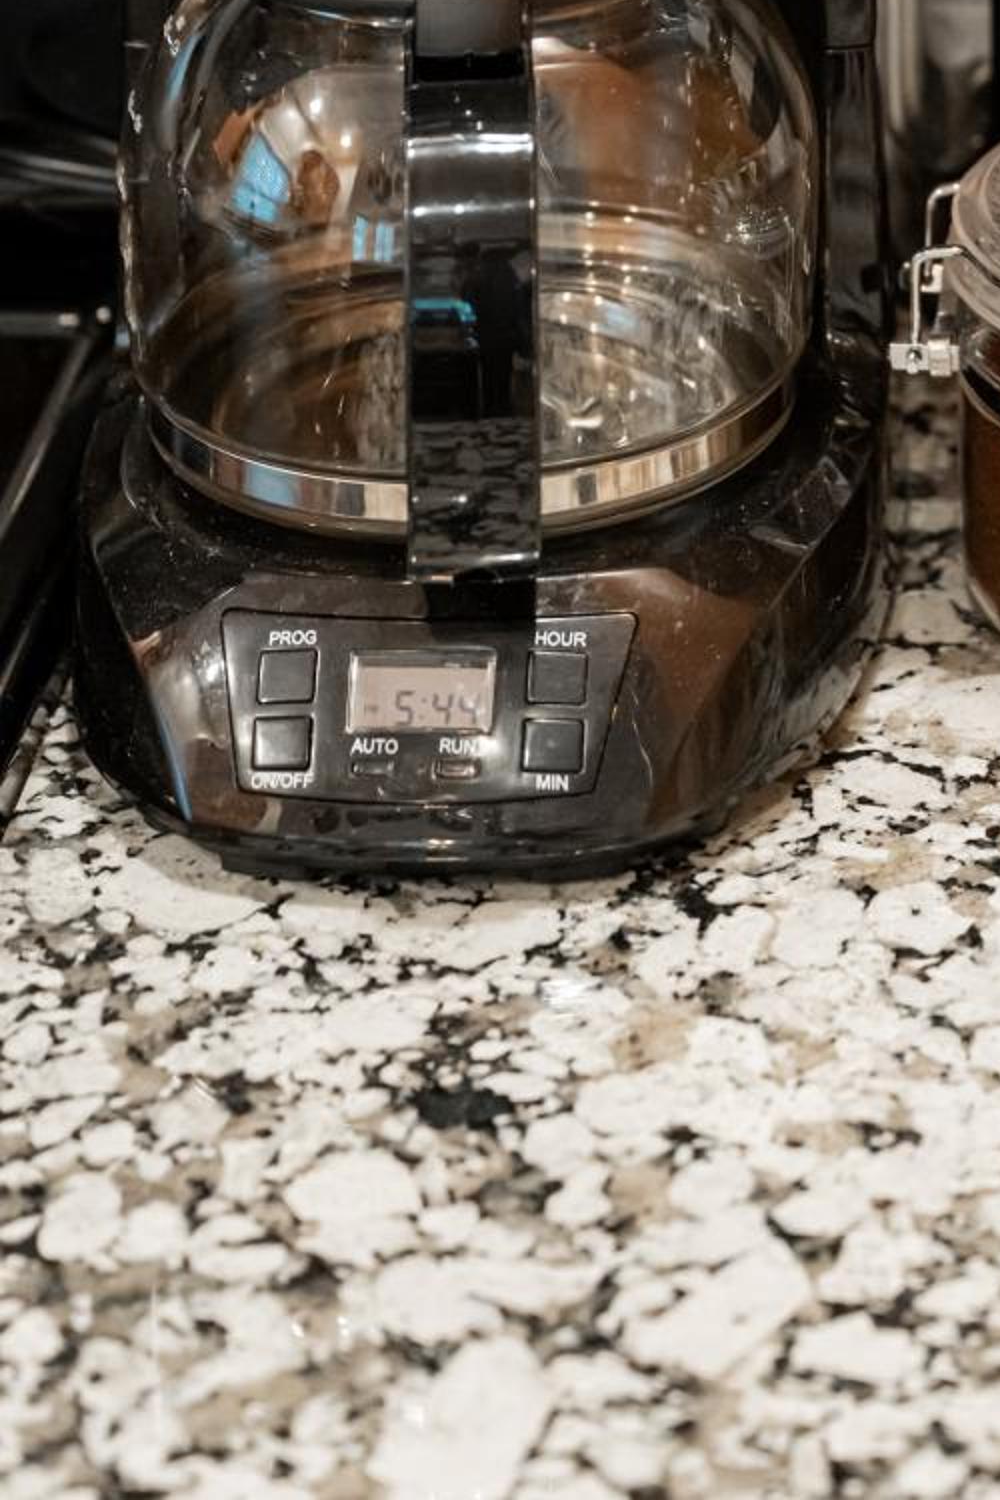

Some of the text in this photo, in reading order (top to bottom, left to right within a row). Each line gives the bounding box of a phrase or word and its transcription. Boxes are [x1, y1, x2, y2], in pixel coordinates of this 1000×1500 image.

[269, 630, 318, 646] PROG
[534, 632, 587, 648] HOUR
[394, 689, 482, 726] 5:44
[350, 738, 399, 756] AUTO
[439, 738, 479, 755] RUN
[250, 771, 315, 790] ON/OFF
[535, 775, 570, 792] MIN
